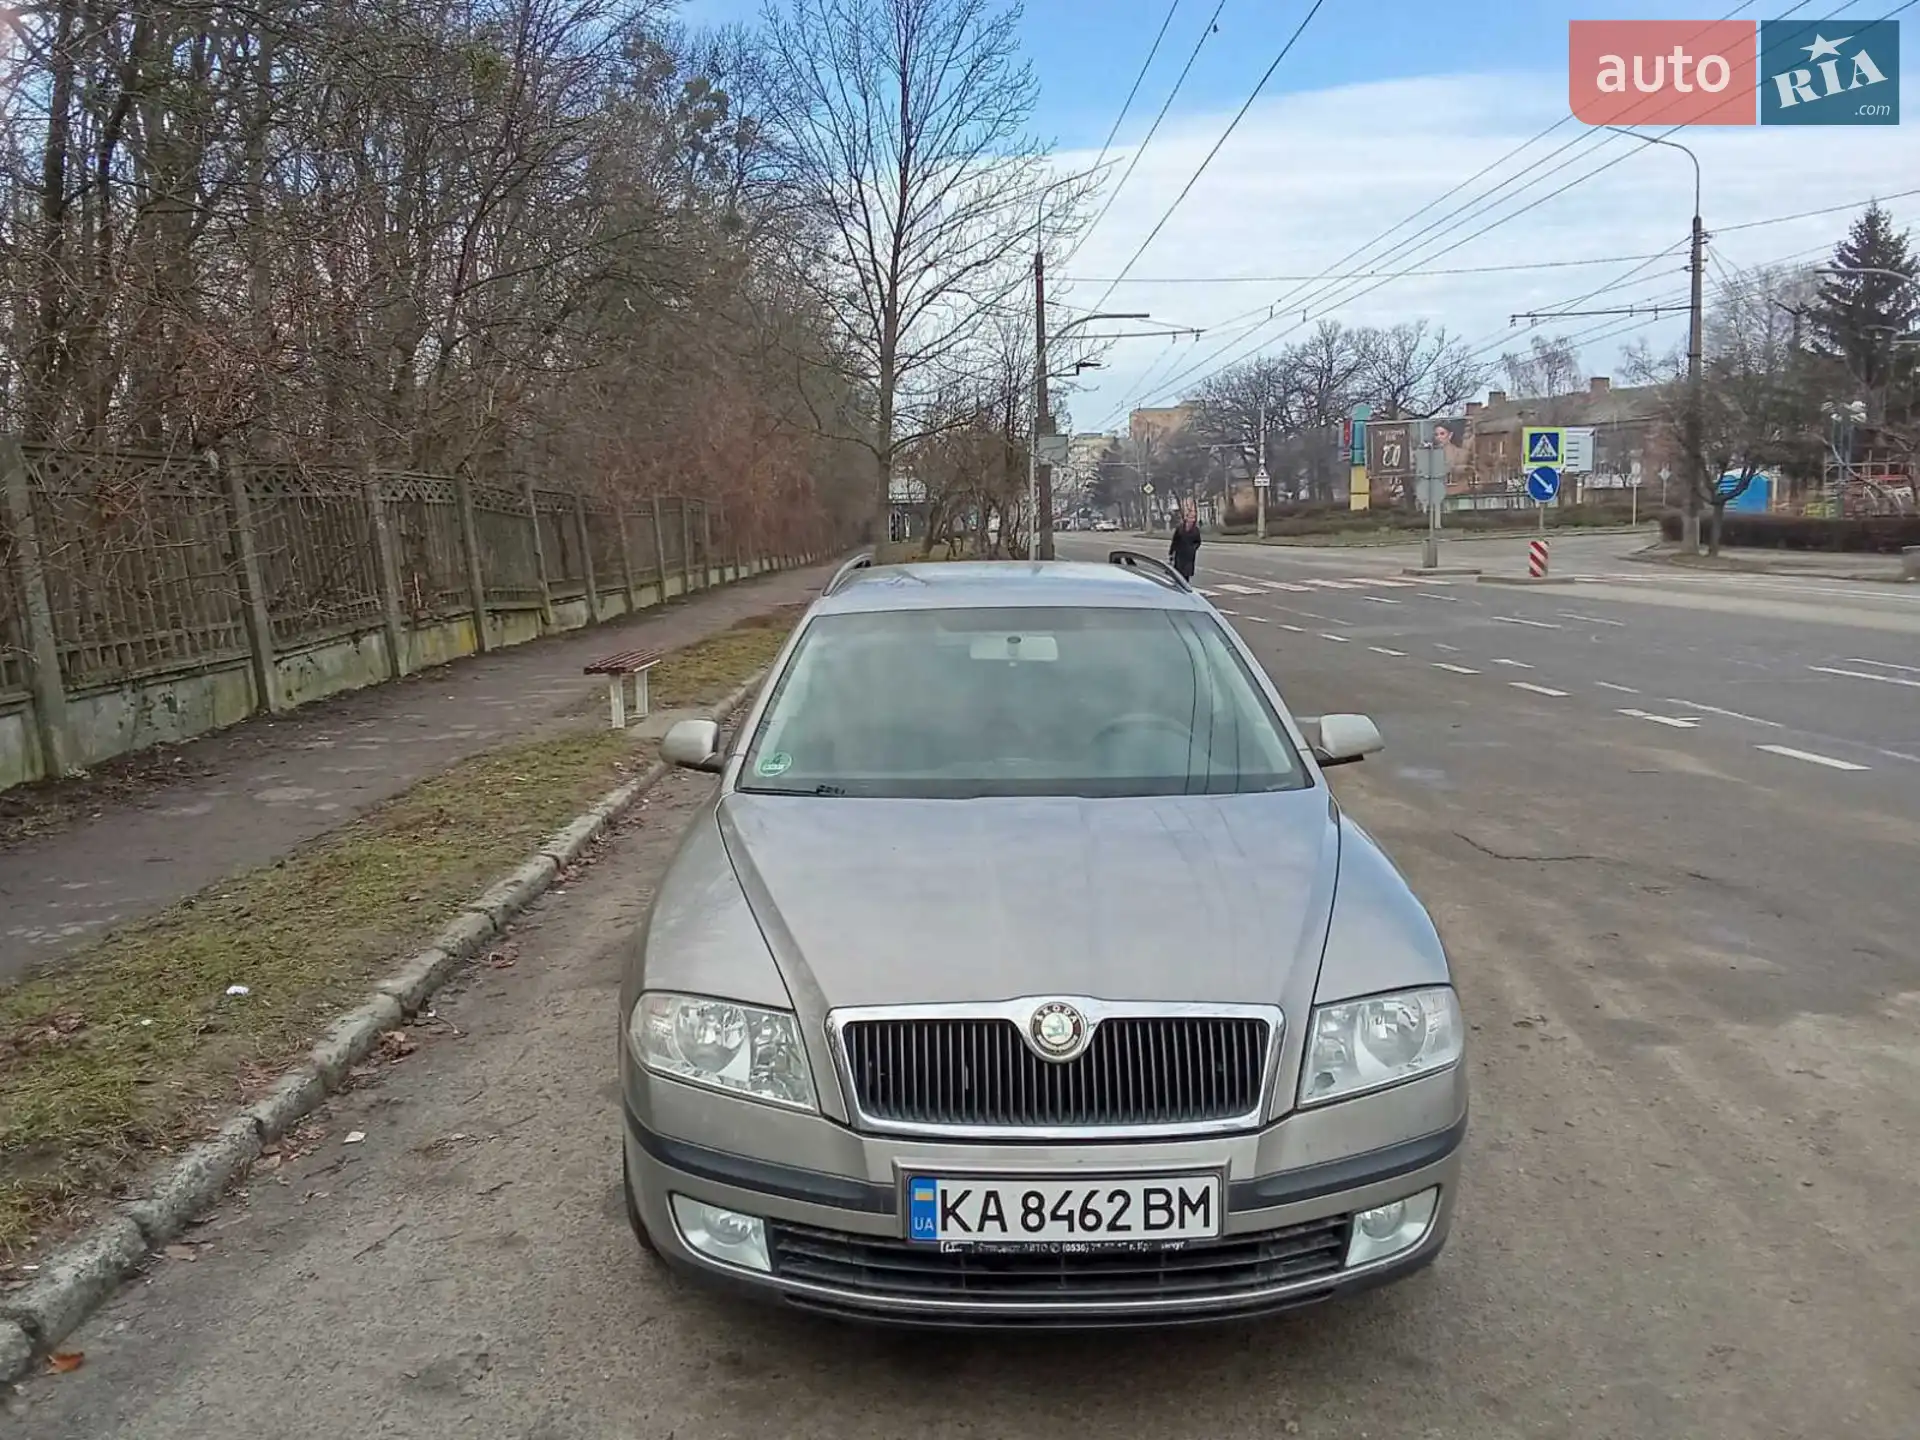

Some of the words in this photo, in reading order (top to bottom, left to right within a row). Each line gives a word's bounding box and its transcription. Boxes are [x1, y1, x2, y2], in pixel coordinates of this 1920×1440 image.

[914, 1217, 934, 1231] UA
[940, 1189, 1008, 1232] KA
[1020, 1188, 1132, 1232] 8462
[1143, 1186, 1211, 1231] BM
